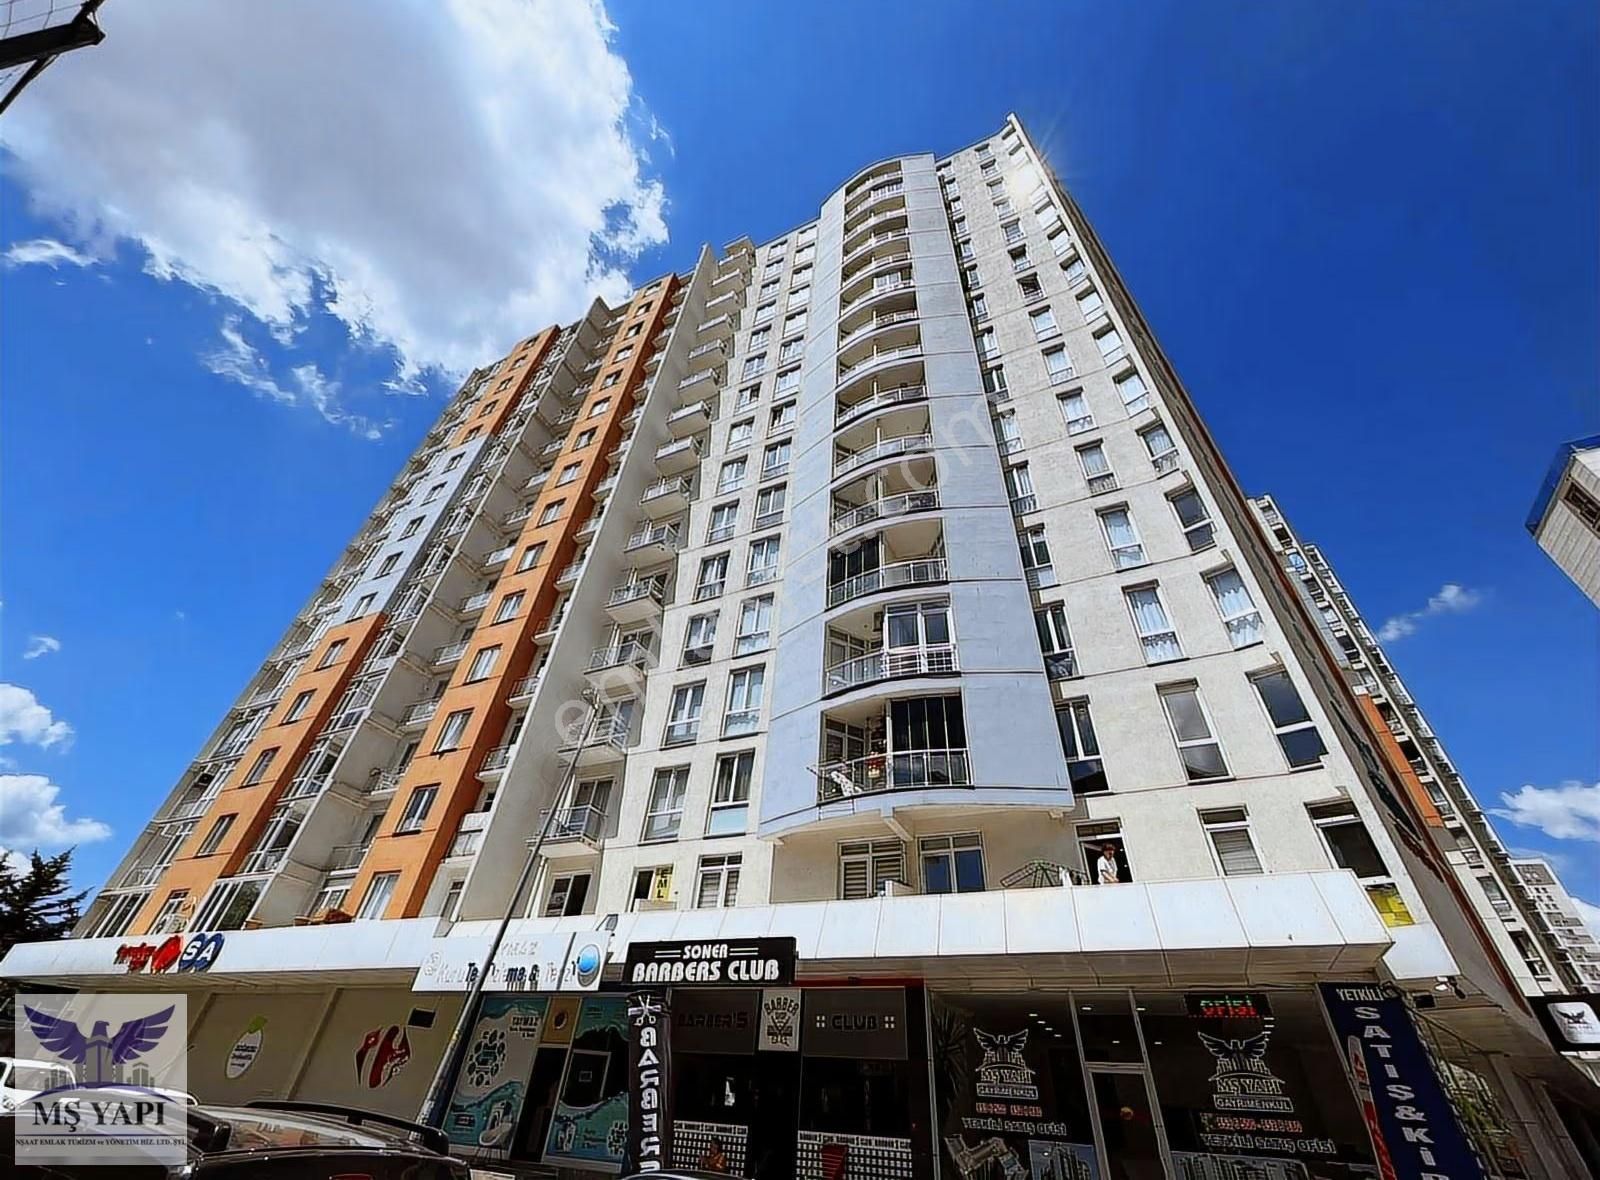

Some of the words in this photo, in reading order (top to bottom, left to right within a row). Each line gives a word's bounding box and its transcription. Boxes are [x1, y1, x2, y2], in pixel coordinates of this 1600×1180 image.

[682, 943, 729, 960] SONER
[632, 960, 722, 983] BARBERS
[727, 959, 780, 981] CLUB
[831, 1013, 879, 1031] CLUB
